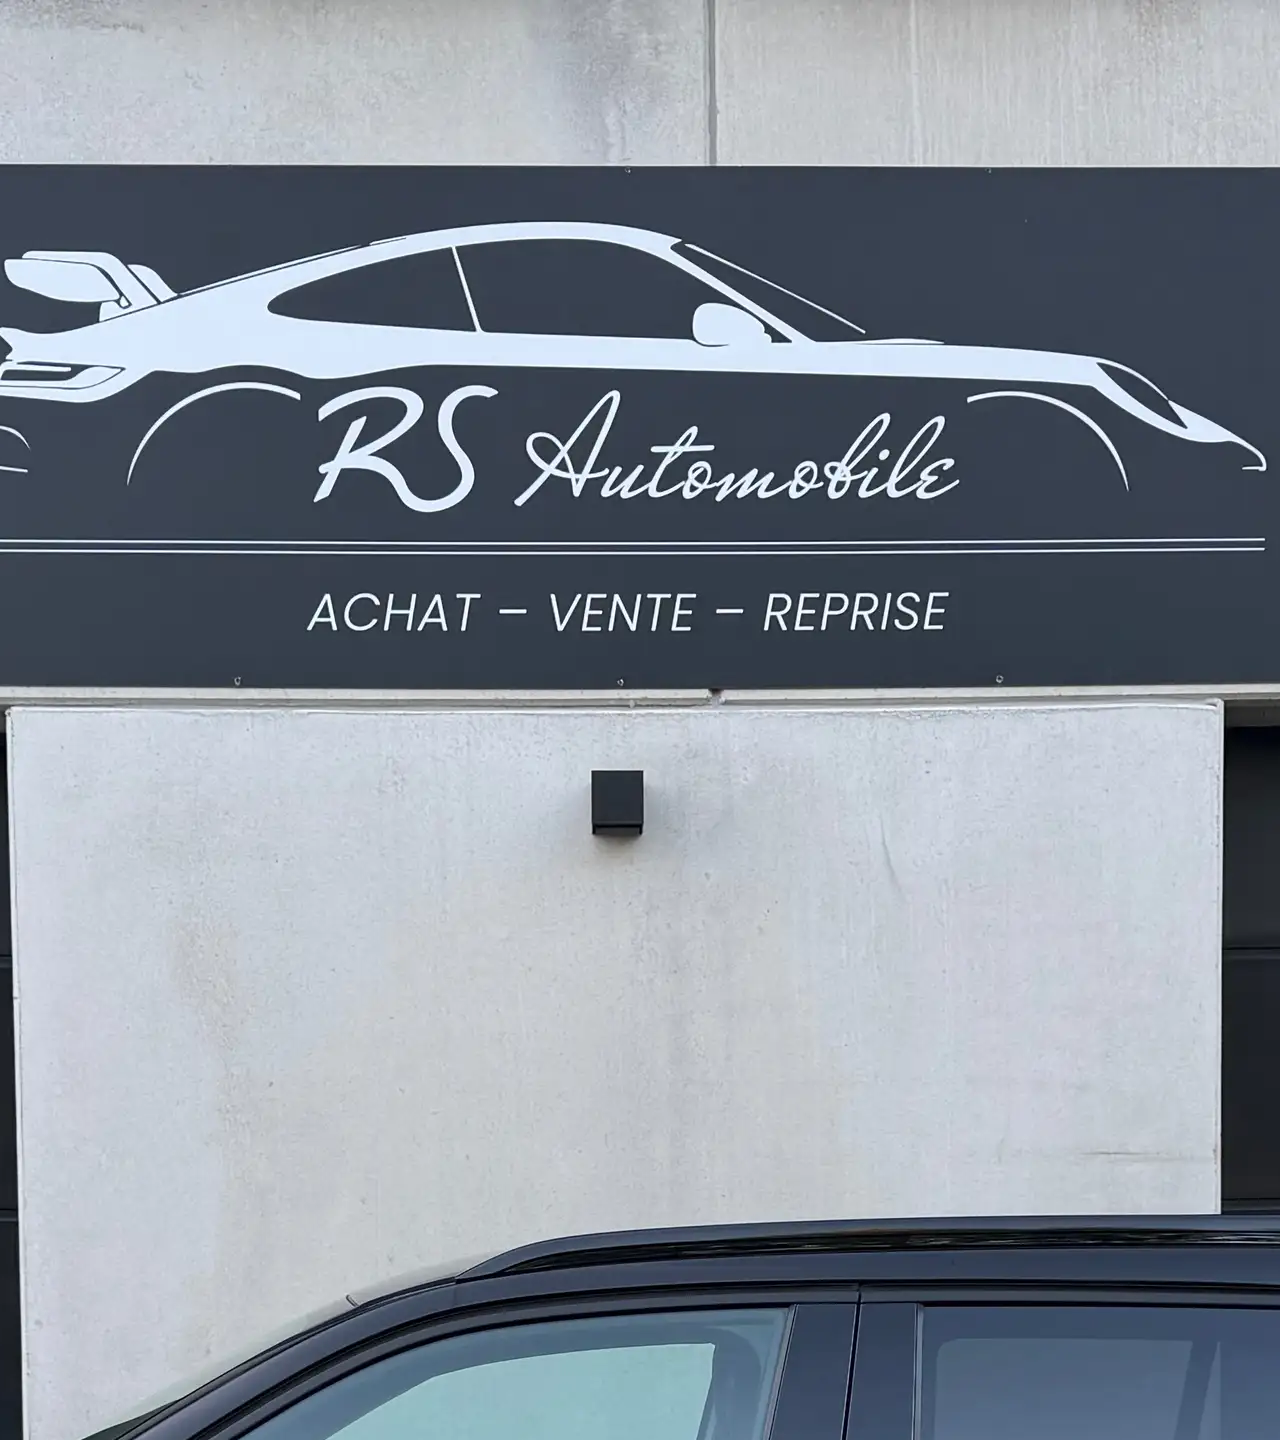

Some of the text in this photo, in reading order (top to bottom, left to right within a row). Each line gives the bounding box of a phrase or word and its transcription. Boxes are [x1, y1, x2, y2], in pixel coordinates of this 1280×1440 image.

[313, 384, 960, 513] RS Automobile
[306, 592, 482, 632] ACHAT
[550, 592, 697, 632] VENTE
[763, 591, 950, 631] REPRISE
